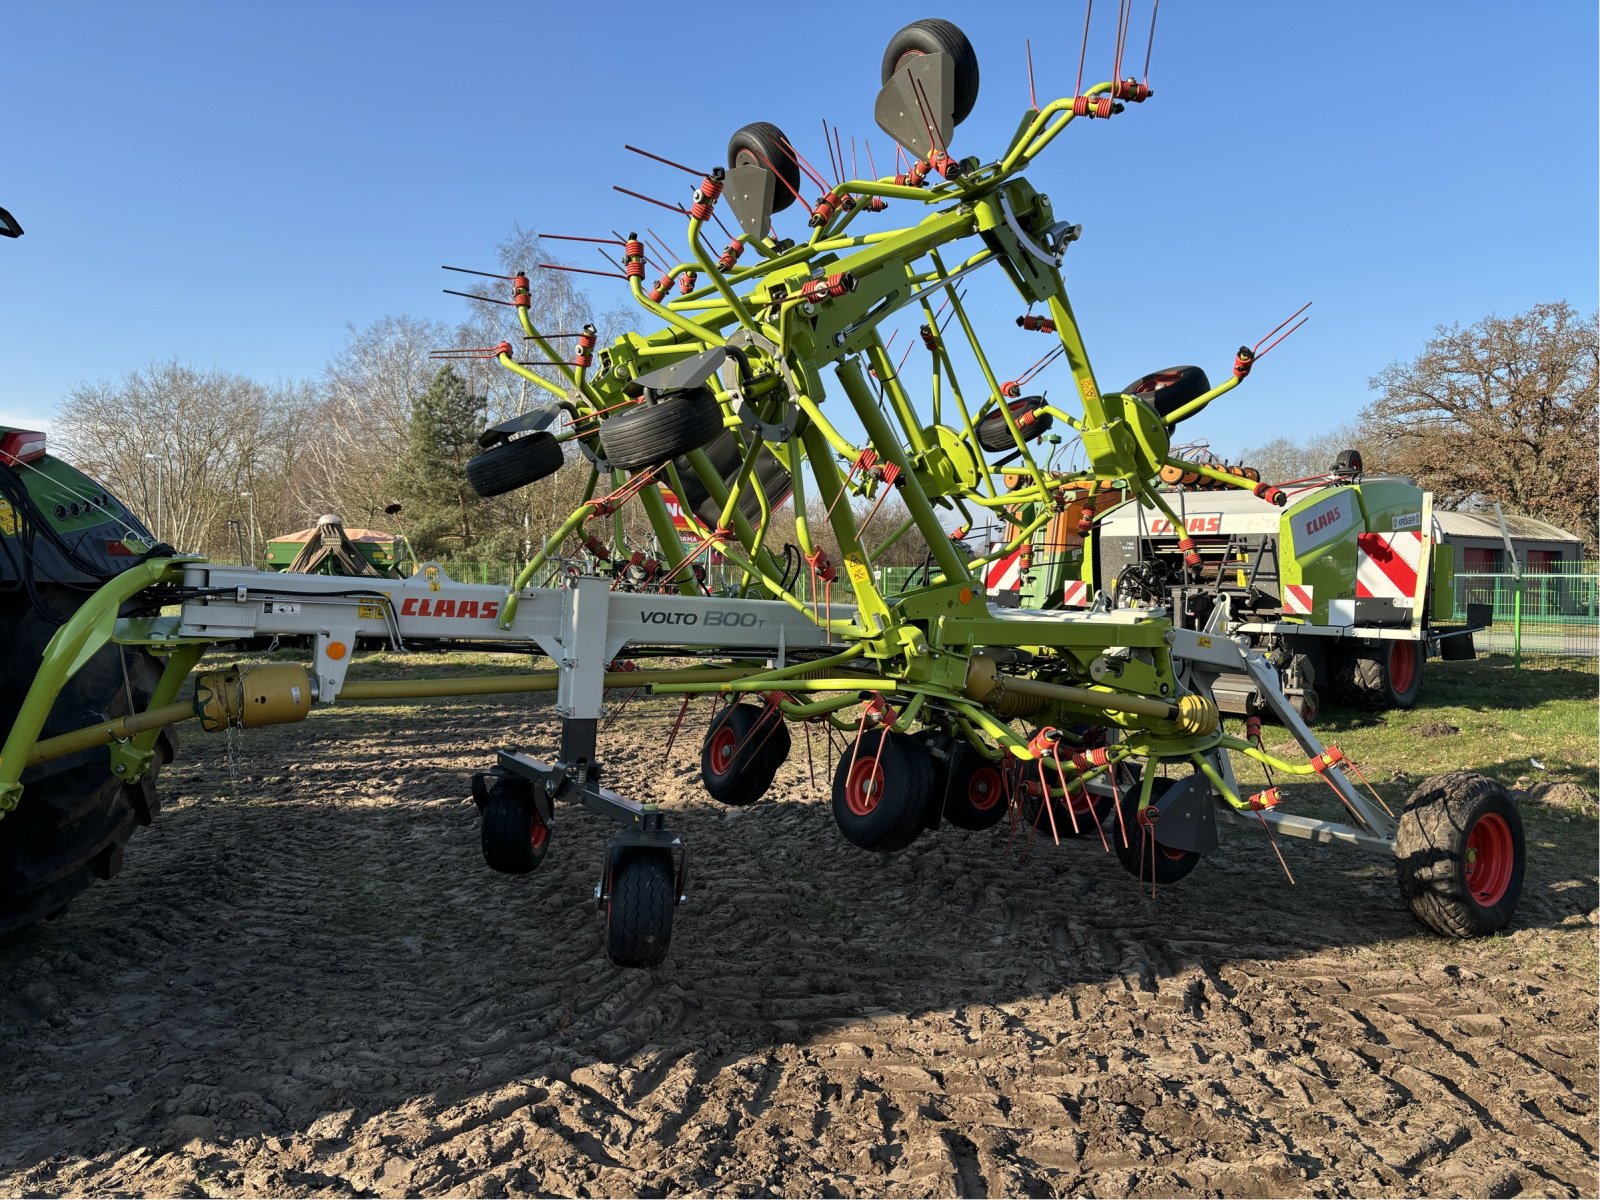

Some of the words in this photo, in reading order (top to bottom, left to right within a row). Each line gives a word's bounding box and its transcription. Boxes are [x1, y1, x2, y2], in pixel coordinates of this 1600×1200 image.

[1150, 517, 1220, 533] CLAS
[1305, 506, 1342, 536] CLAAS
[400, 597, 499, 619] CLAAS
[640, 611, 698, 626] VOLTO
